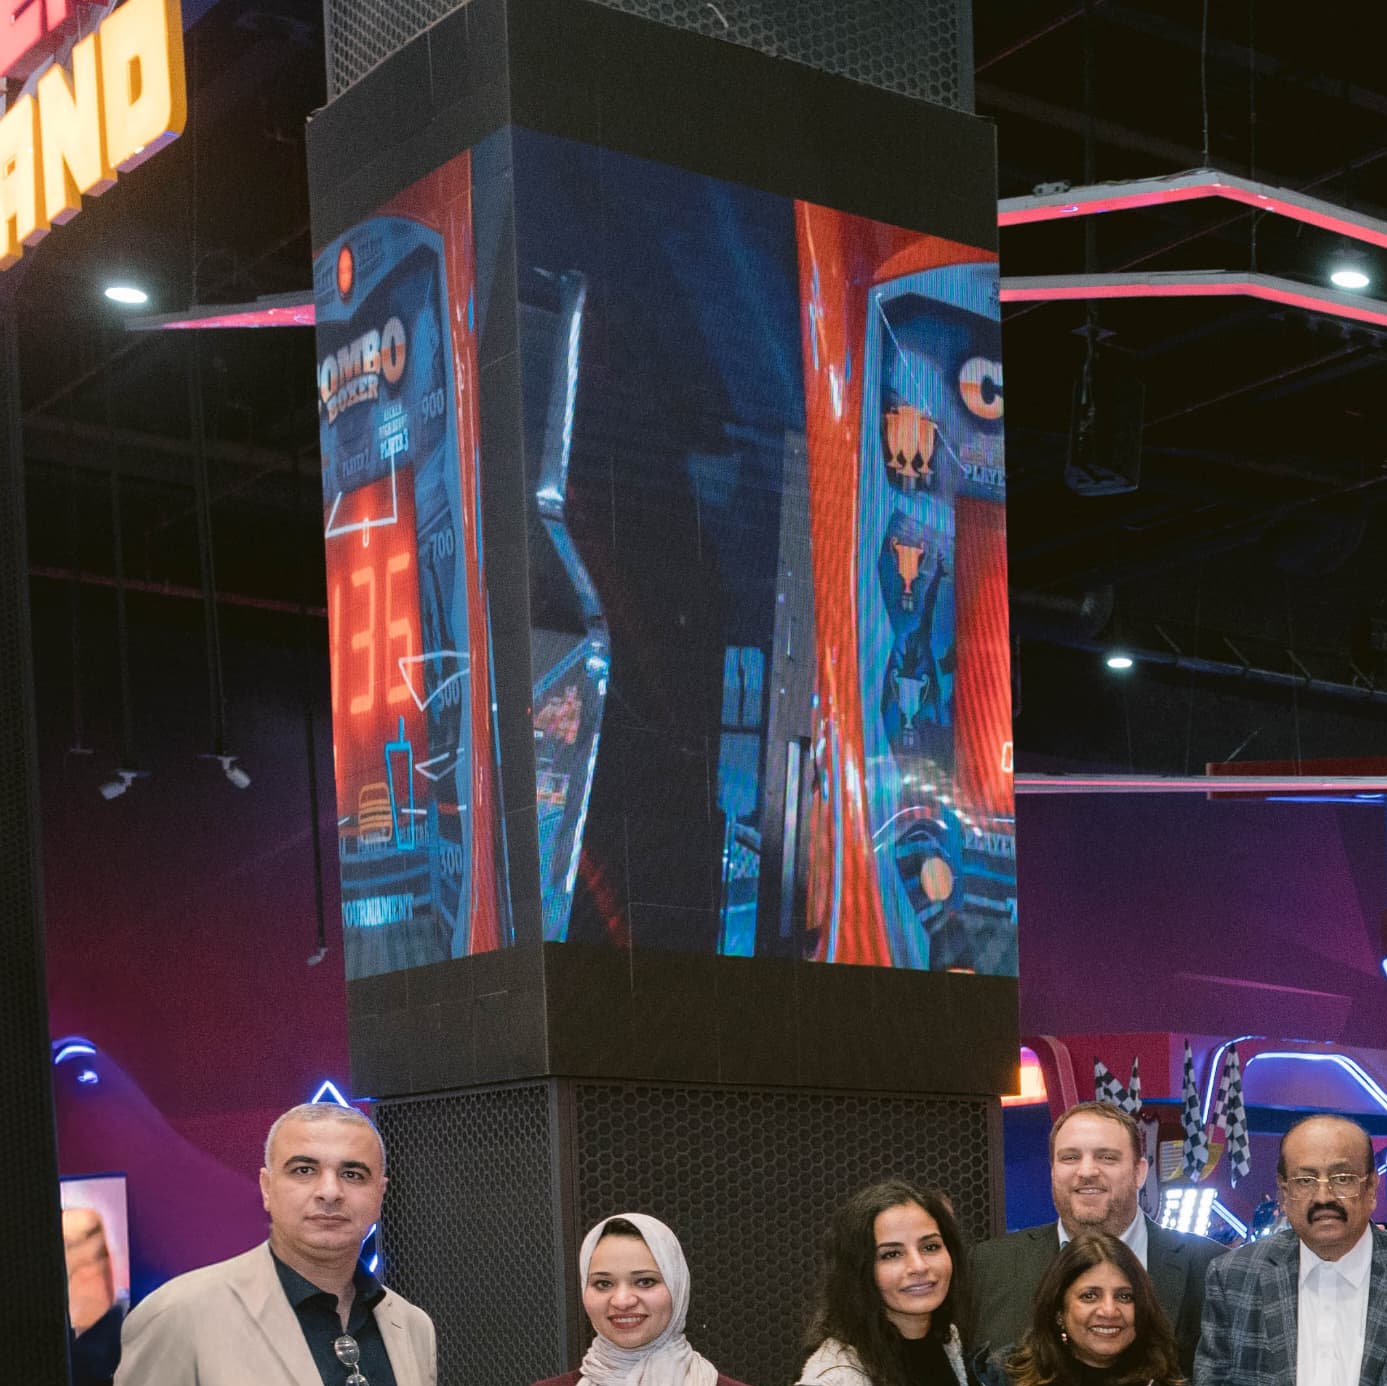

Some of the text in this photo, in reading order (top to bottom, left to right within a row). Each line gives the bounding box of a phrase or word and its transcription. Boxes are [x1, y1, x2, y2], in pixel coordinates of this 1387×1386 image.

[317, 316, 407, 403] OMBO
[326, 373, 379, 425] BOXER
[422, 387, 445, 424] 900
[429, 532, 454, 563] 700
